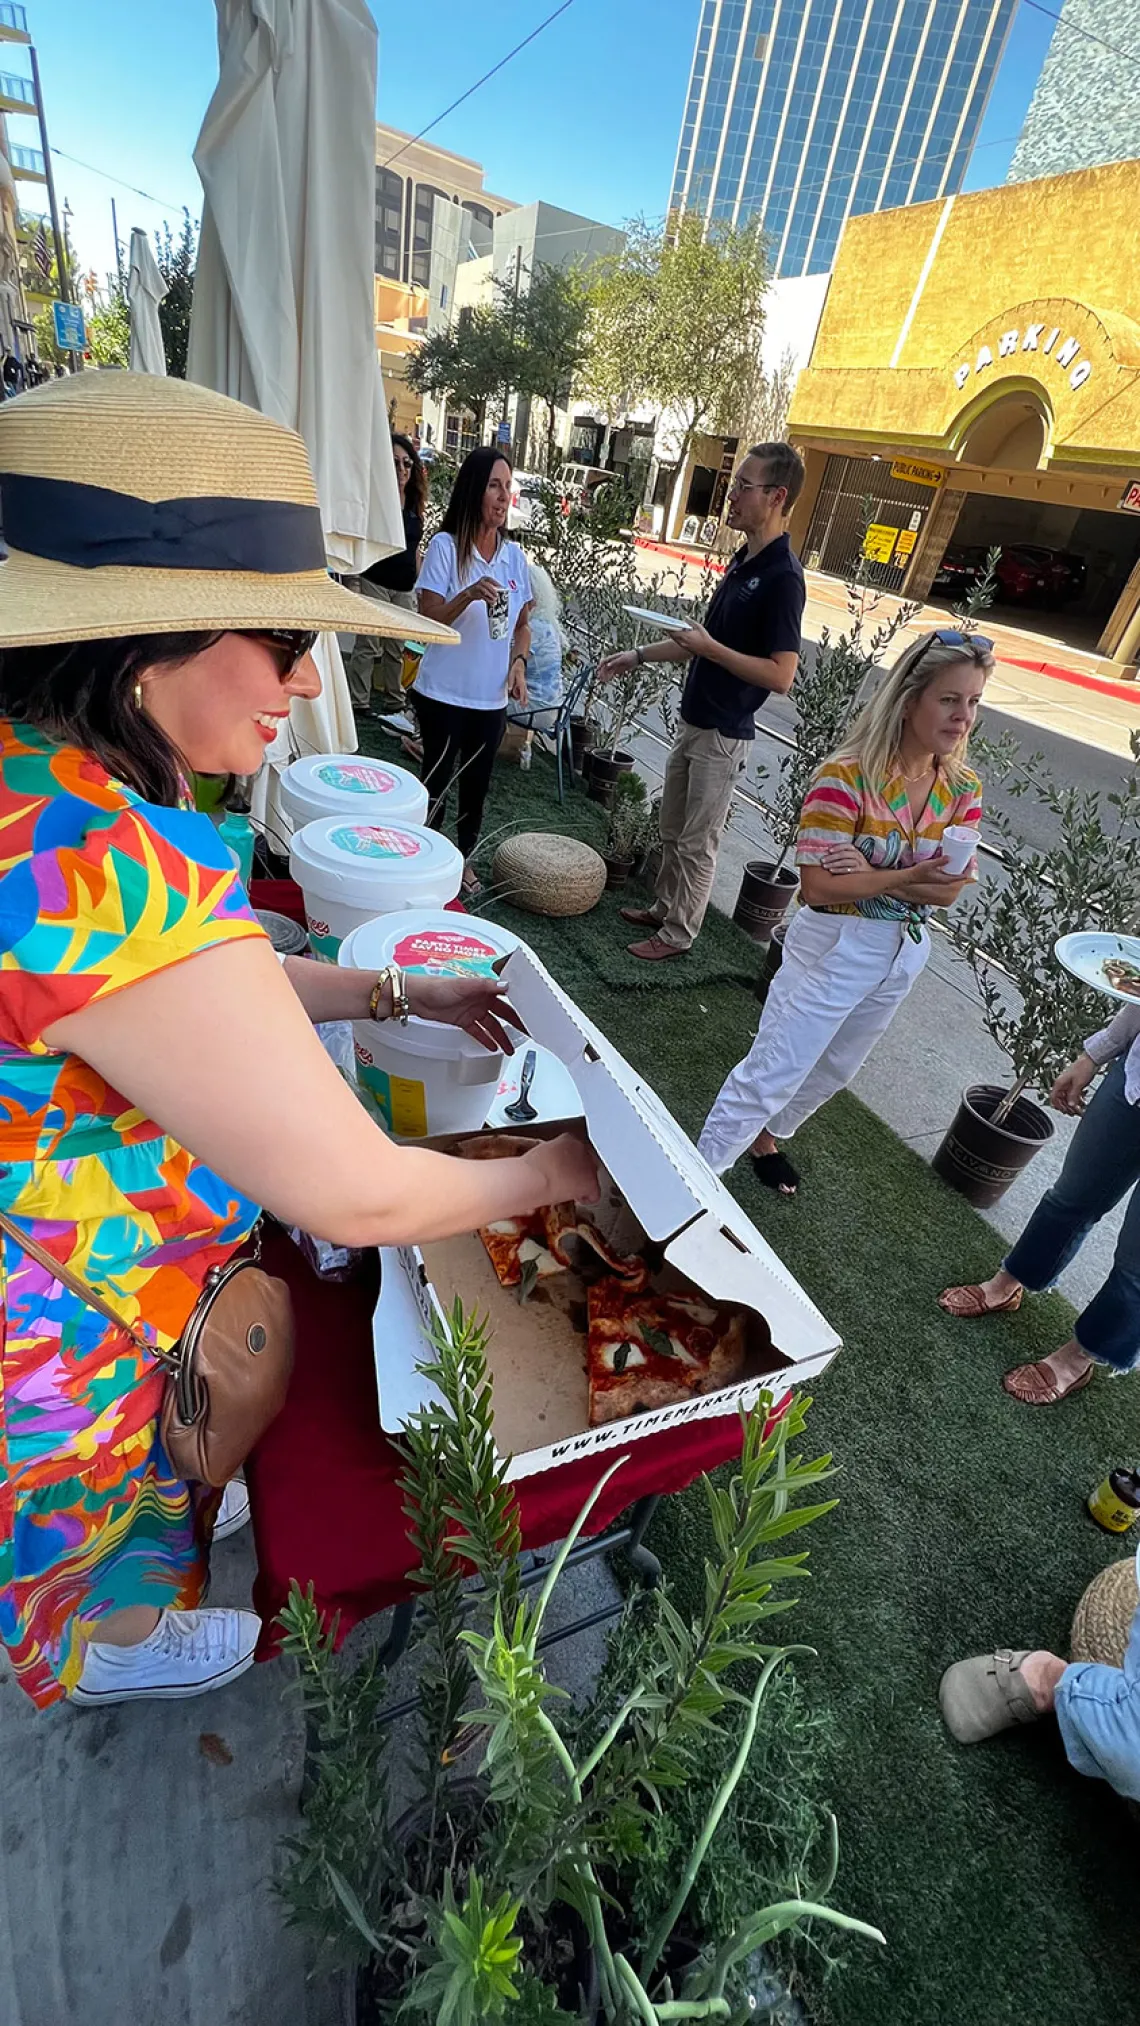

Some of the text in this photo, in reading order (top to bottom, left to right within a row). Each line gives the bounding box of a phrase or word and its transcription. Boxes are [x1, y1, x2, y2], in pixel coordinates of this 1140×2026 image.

[953, 323, 1091, 391] PARKING
[893, 461, 934, 481] PUBLIC PARKING
[414, 939, 452, 948] PARTY
